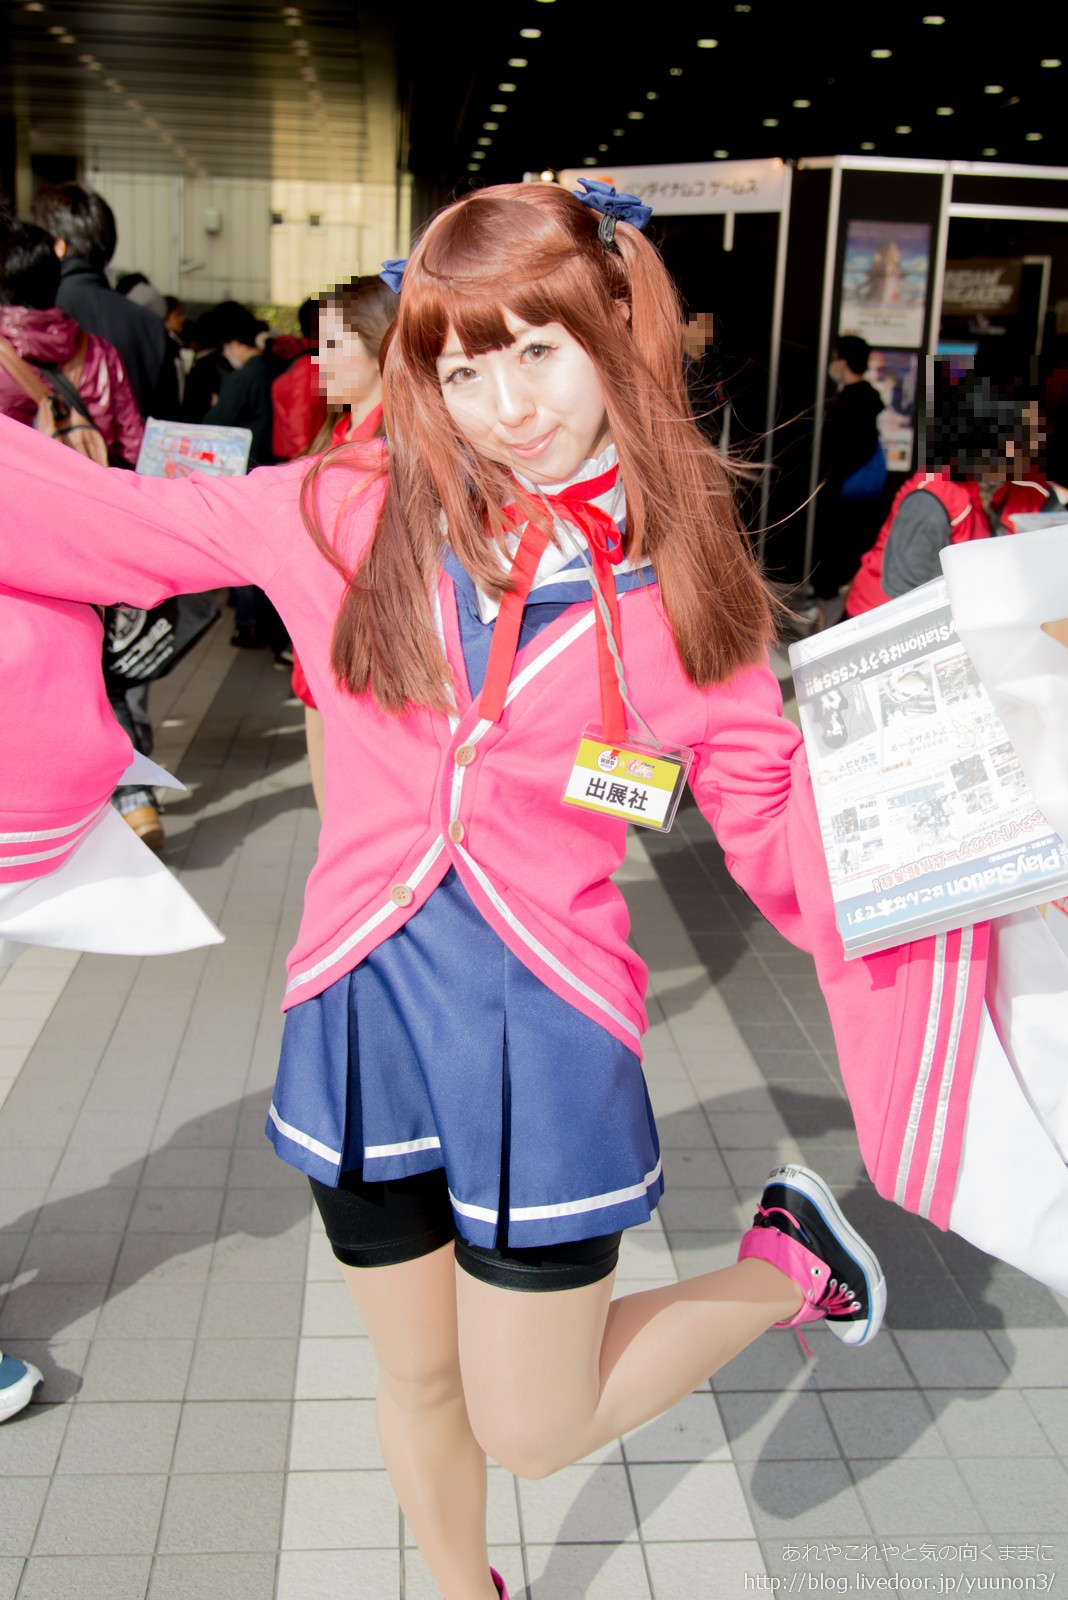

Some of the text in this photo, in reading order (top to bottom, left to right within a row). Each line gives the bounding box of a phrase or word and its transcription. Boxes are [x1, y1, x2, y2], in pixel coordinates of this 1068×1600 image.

[585, 777, 649, 812] 出展社
[944, 848, 1060, 898] PlayStation
